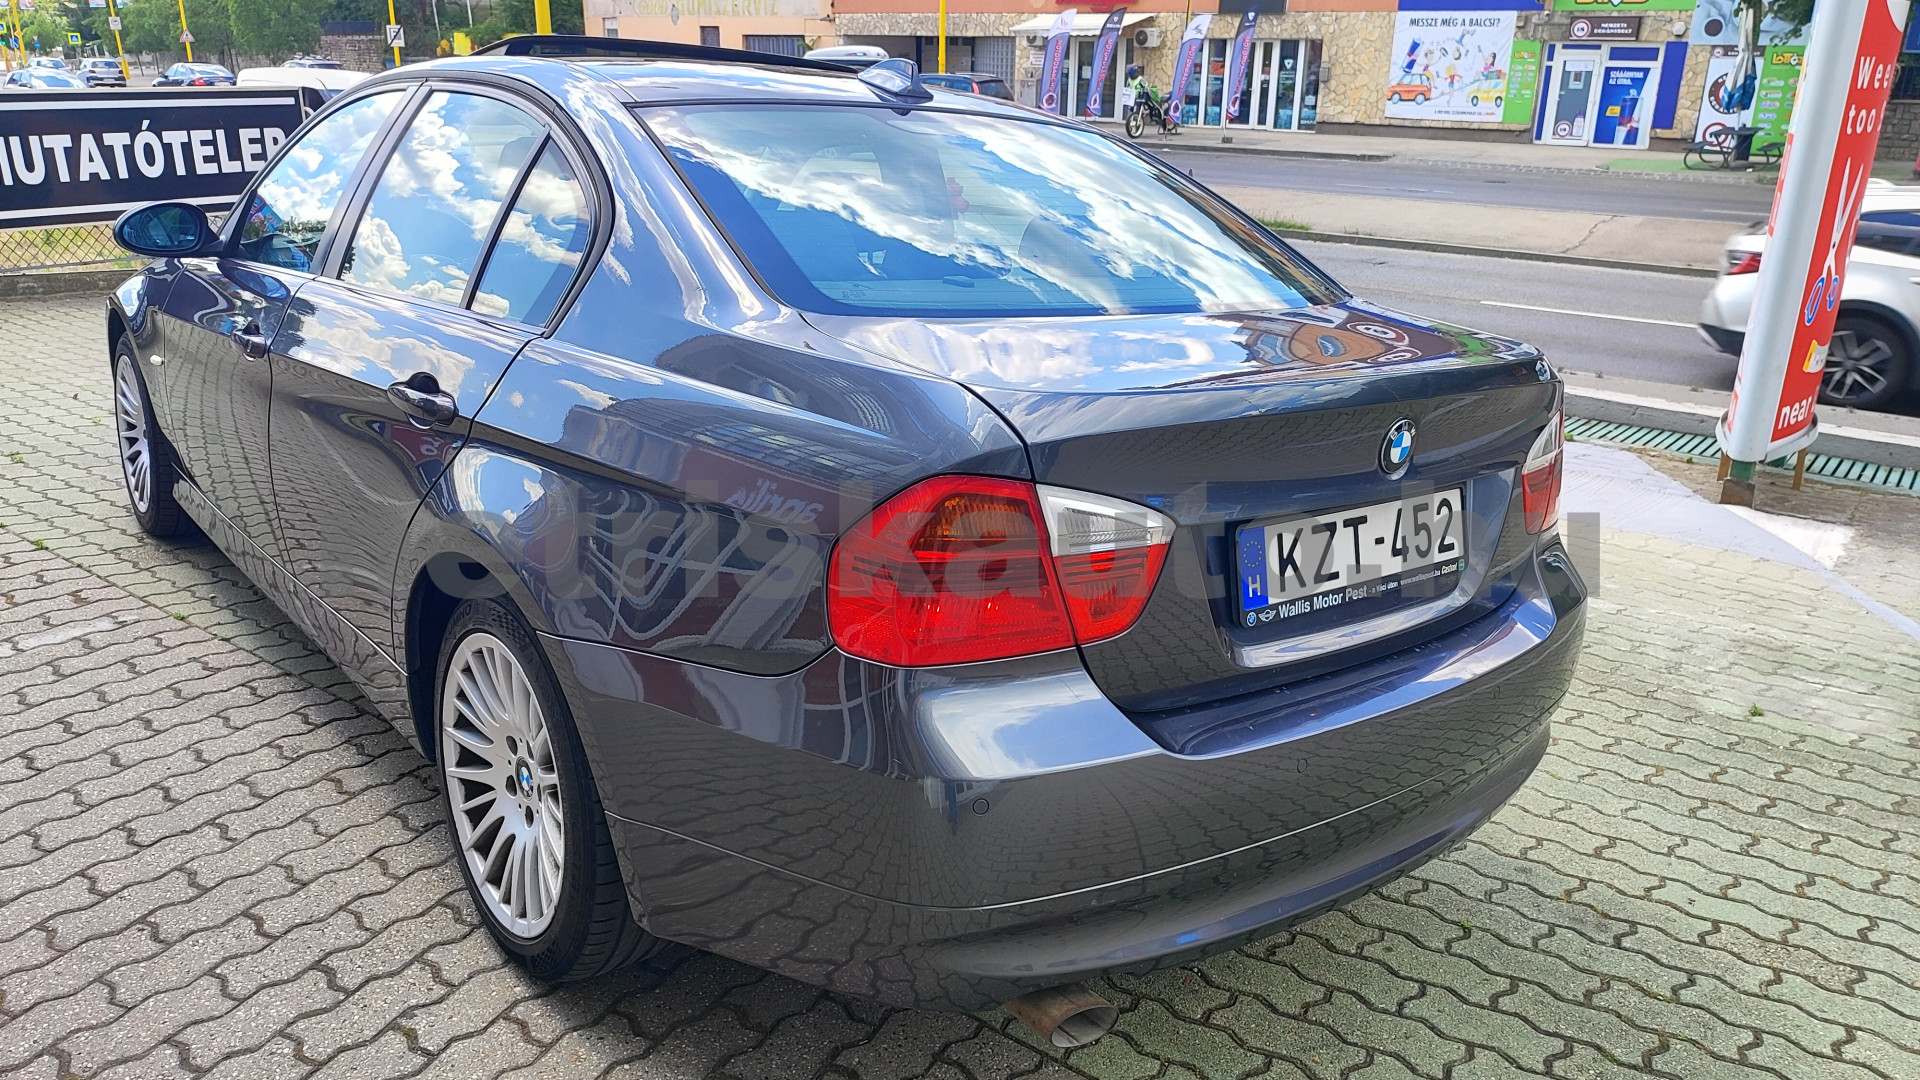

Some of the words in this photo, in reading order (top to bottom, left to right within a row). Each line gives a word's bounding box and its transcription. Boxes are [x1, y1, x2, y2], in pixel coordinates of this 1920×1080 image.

[1408, 17, 1438, 28] MESSZE
[1439, 16, 1458, 28] MÉG
[1460, 18, 1466, 28] A
[1468, 17, 1500, 28] BALCSI?
[1276, 497, 1455, 593] KZT-452
[1248, 574, 1261, 598] H
[1279, 600, 1311, 619] Wallis
[1313, 592, 1344, 611] Motor
[1345, 584, 1368, 602] Pest
